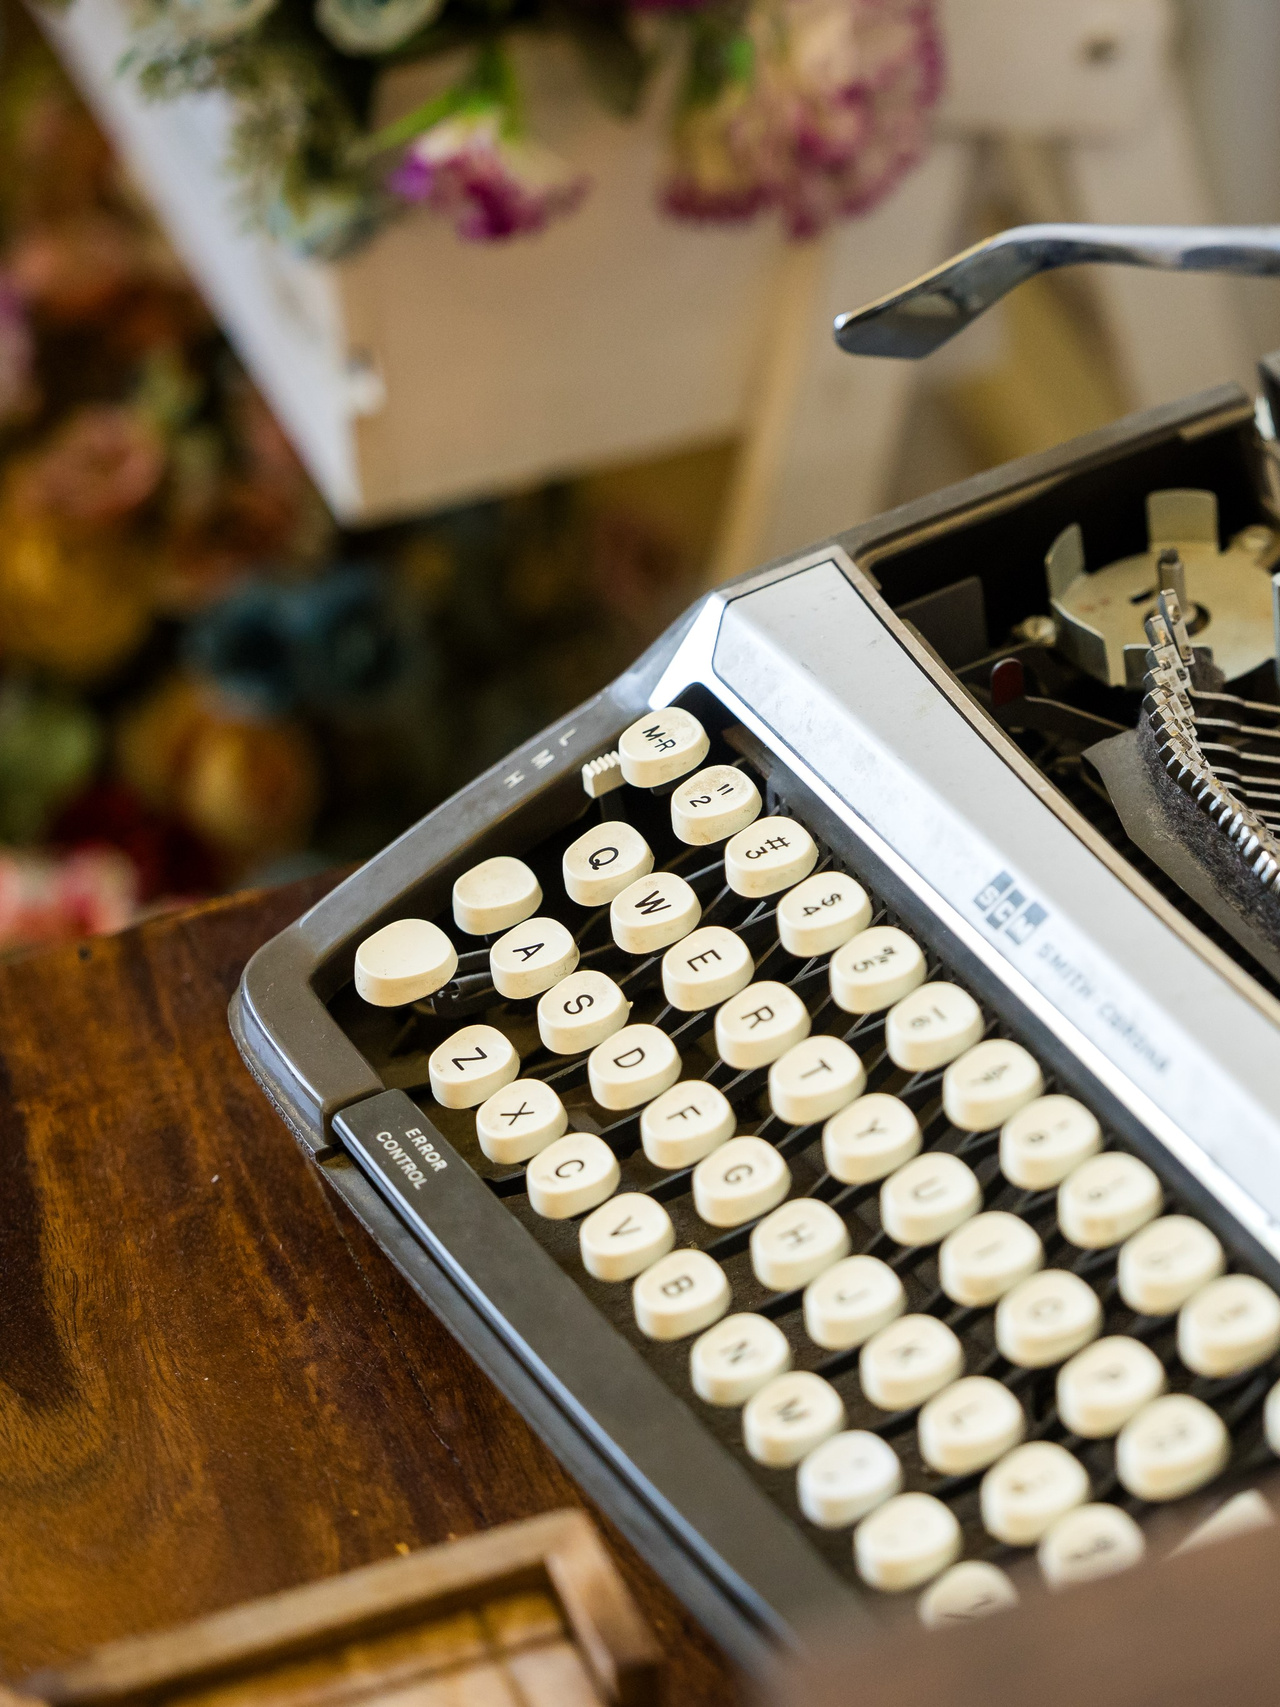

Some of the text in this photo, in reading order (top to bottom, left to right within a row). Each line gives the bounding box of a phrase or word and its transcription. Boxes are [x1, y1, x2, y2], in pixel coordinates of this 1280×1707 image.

[642, 725, 676, 752] M-R
[530, 749, 554, 769] M
[504, 770, 525, 788] H
[689, 795, 712, 808] 2
[588, 846, 620, 871] Q
[745, 846, 768, 860] 3
[634, 889, 672, 916] W
[802, 906, 821, 917] 4
[977, 880, 1042, 943] SCM
[512, 942, 545, 963] A
[686, 948, 722, 973] E
[852, 958, 876, 973] 5
[563, 994, 595, 1015] S
[740, 1005, 775, 1030] R
[451, 1046, 488, 1072] Z
[612, 1047, 646, 1069] D
[801, 1058, 833, 1079] T
[500, 1101, 535, 1127] X
[667, 1105, 702, 1121] F
[856, 1118, 888, 1139] Y
[376, 1131, 428, 1190] CONTROL
[405, 1127, 448, 1172] ERROR
[555, 1159, 585, 1179] C
[722, 1163, 754, 1184] G
[911, 1177, 944, 1202] U
[610, 1216, 642, 1238] V
[660, 1274, 694, 1298] B
